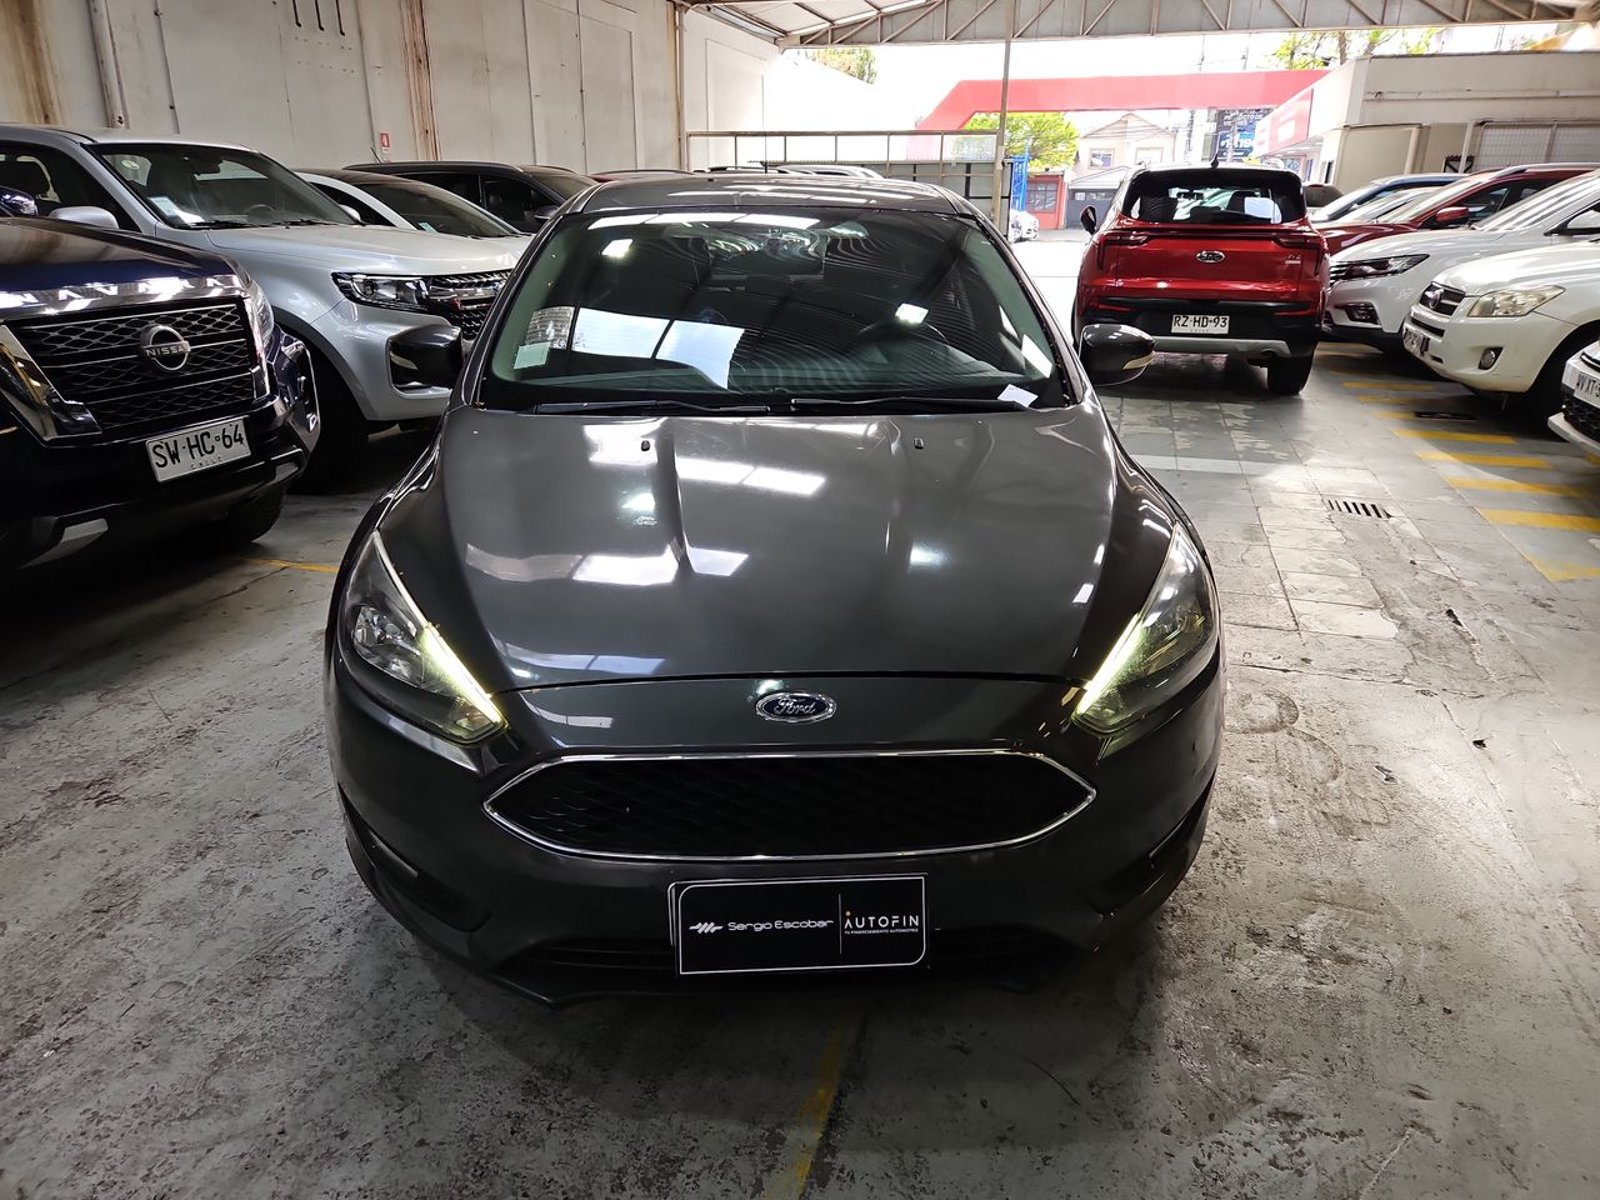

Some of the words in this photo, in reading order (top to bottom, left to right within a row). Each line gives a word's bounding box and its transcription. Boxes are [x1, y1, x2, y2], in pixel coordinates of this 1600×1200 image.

[145, 343, 190, 357] NISSA
[773, 697, 817, 715] Ford
[774, 919, 834, 929] Escobar
[844, 911, 919, 929] AUTOFIN
